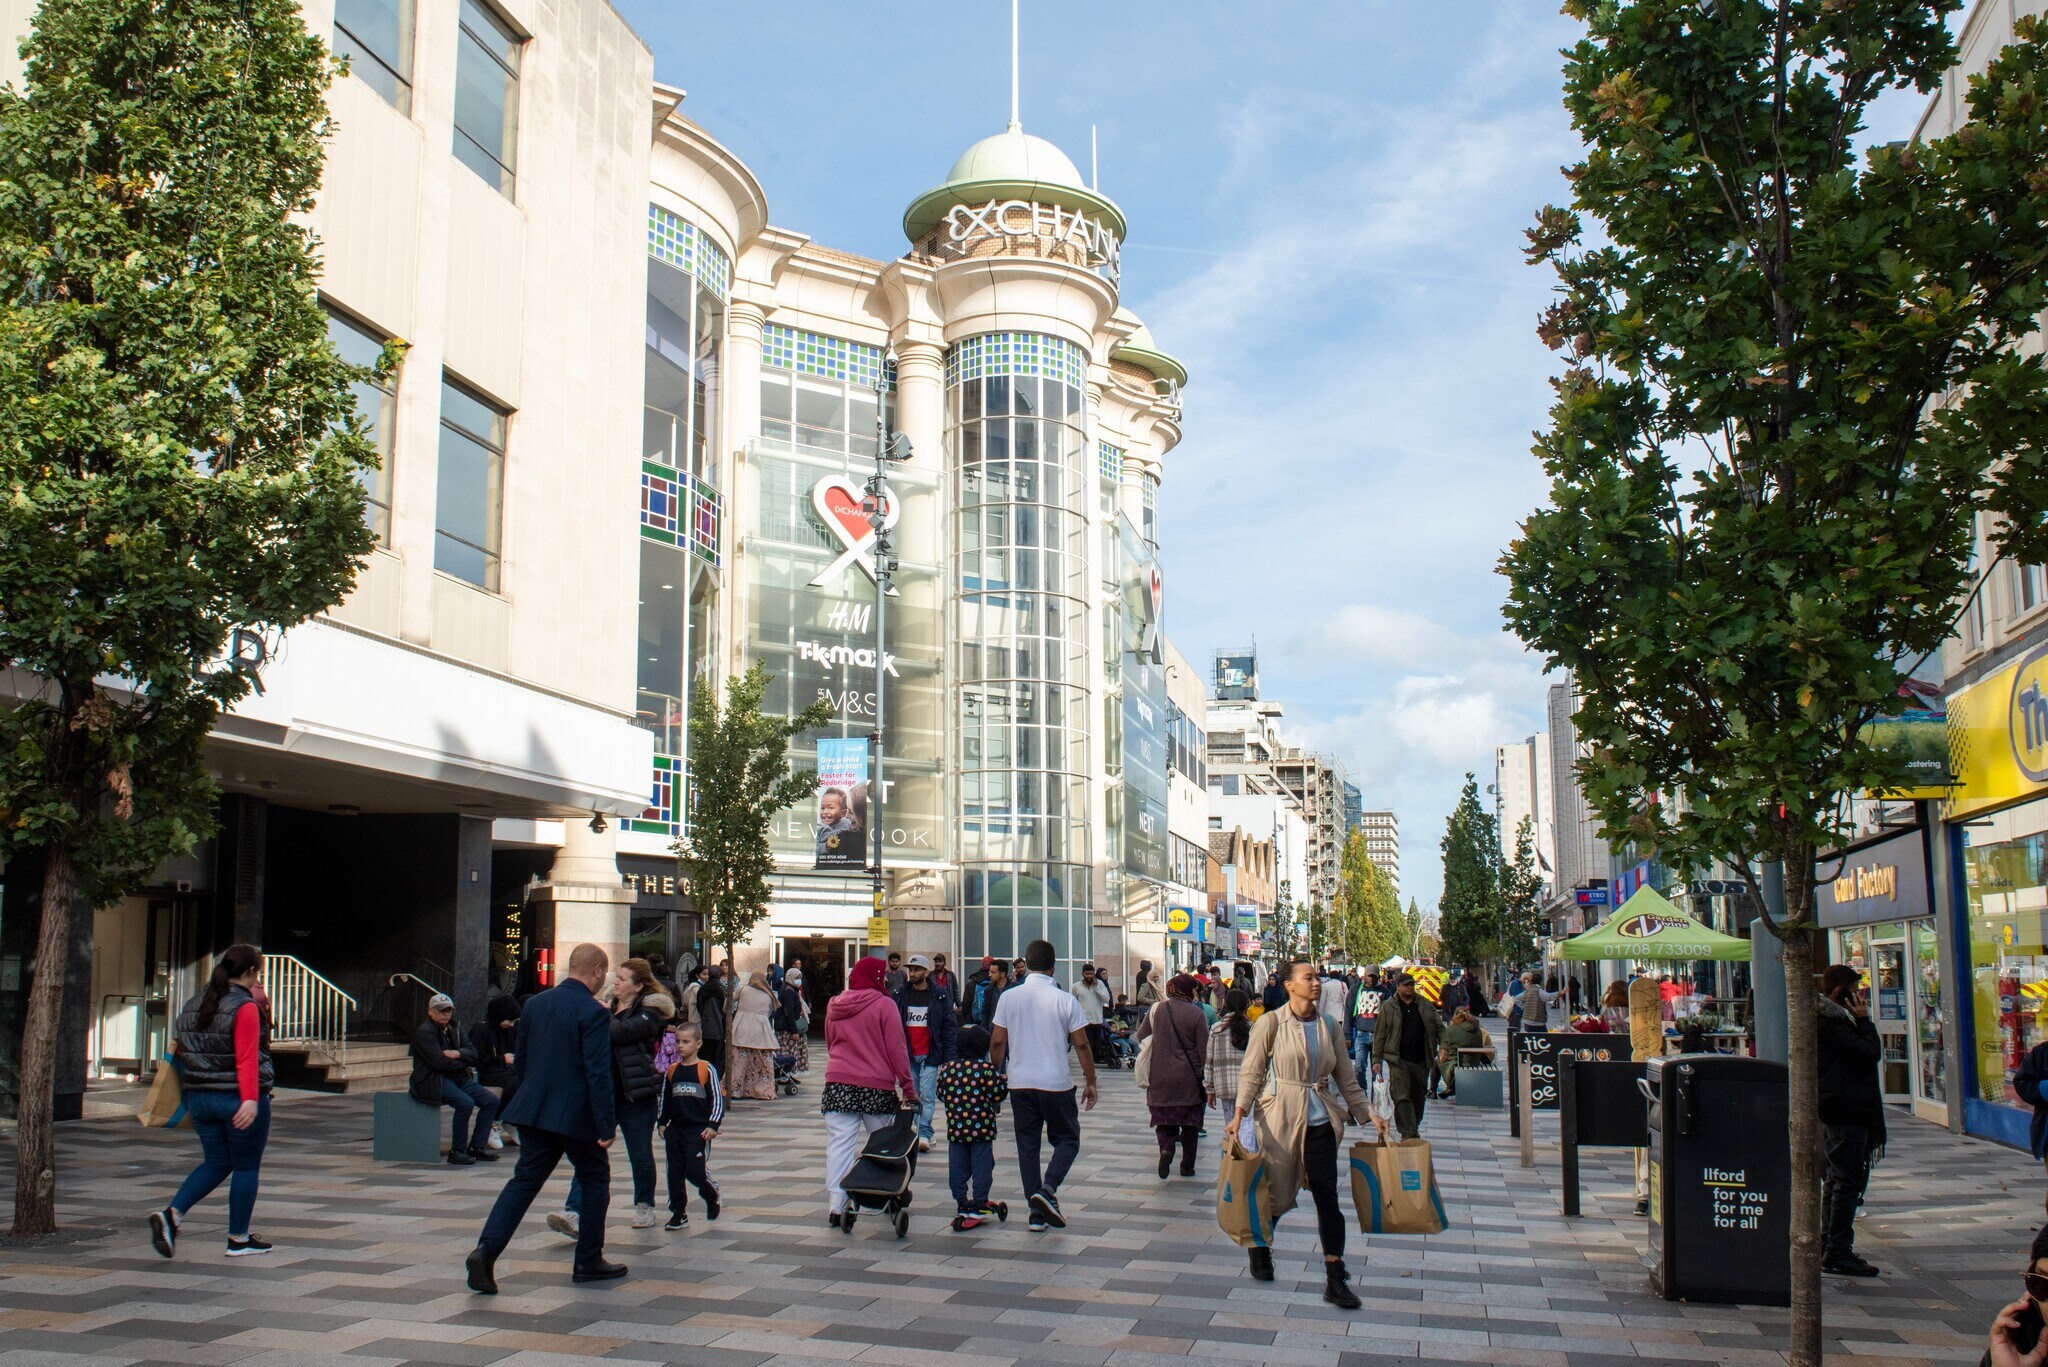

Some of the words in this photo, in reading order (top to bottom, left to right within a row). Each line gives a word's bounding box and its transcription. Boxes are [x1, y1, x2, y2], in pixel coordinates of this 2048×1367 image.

[827, 601, 872, 634] H&M
[825, 688, 877, 716] M&S
[820, 756, 836, 764] Give
[842, 755, 860, 763] child
[1904, 760, 1941, 770] ostering
[820, 779, 857, 787] Redbridge
[1138, 809, 1155, 836] NEXT
[870, 828, 929, 847] OOK
[625, 873, 675, 895] THE
[1834, 868, 1857, 904] Card
[1857, 862, 1897, 902] Factory
[1647, 913, 1688, 924] Garden
[1654, 919, 1690, 928] Living
[1604, 944, 1651, 957] 01708
[1656, 943, 1712, 956] 733009
[1524, 1036, 1551, 1051] tic
[1530, 1063, 1556, 1078] ac
[1531, 1085, 1557, 1101] oe
[1703, 1168, 1745, 1182] Ilford
[1713, 1187, 1736, 1201] for
[1739, 1191, 1768, 1204] you
[1713, 1200, 1736, 1214] for
[1740, 1205, 1764, 1216] me
[1713, 1214, 1736, 1228] for
[1740, 1216, 1758, 1230] all
